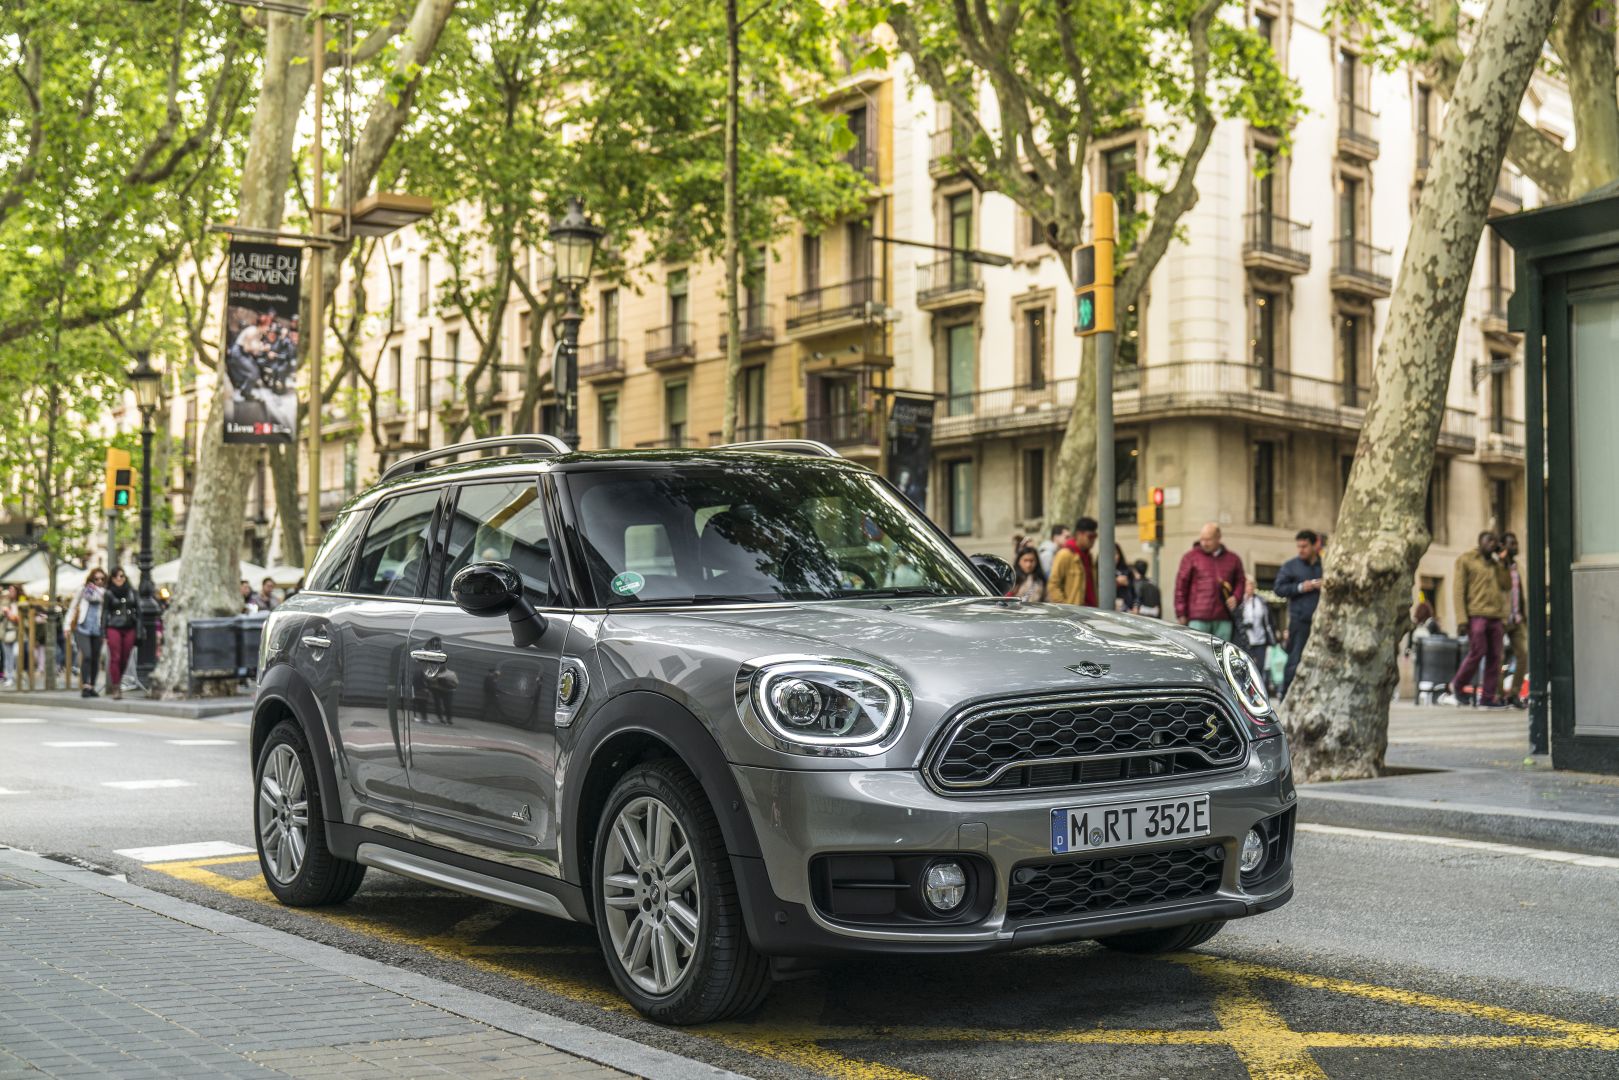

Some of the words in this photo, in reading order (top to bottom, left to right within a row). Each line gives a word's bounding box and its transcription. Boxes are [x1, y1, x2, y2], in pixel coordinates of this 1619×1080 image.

[231, 253, 246, 267] LA
[248, 253, 274, 269] FILLE
[276, 255, 297, 271] DU
[1202, 713, 1217, 740] S
[1071, 812, 1089, 847] M
[1104, 807, 1138, 843] RT
[1145, 800, 1208, 838] 352E
[1057, 835, 1063, 845] D
